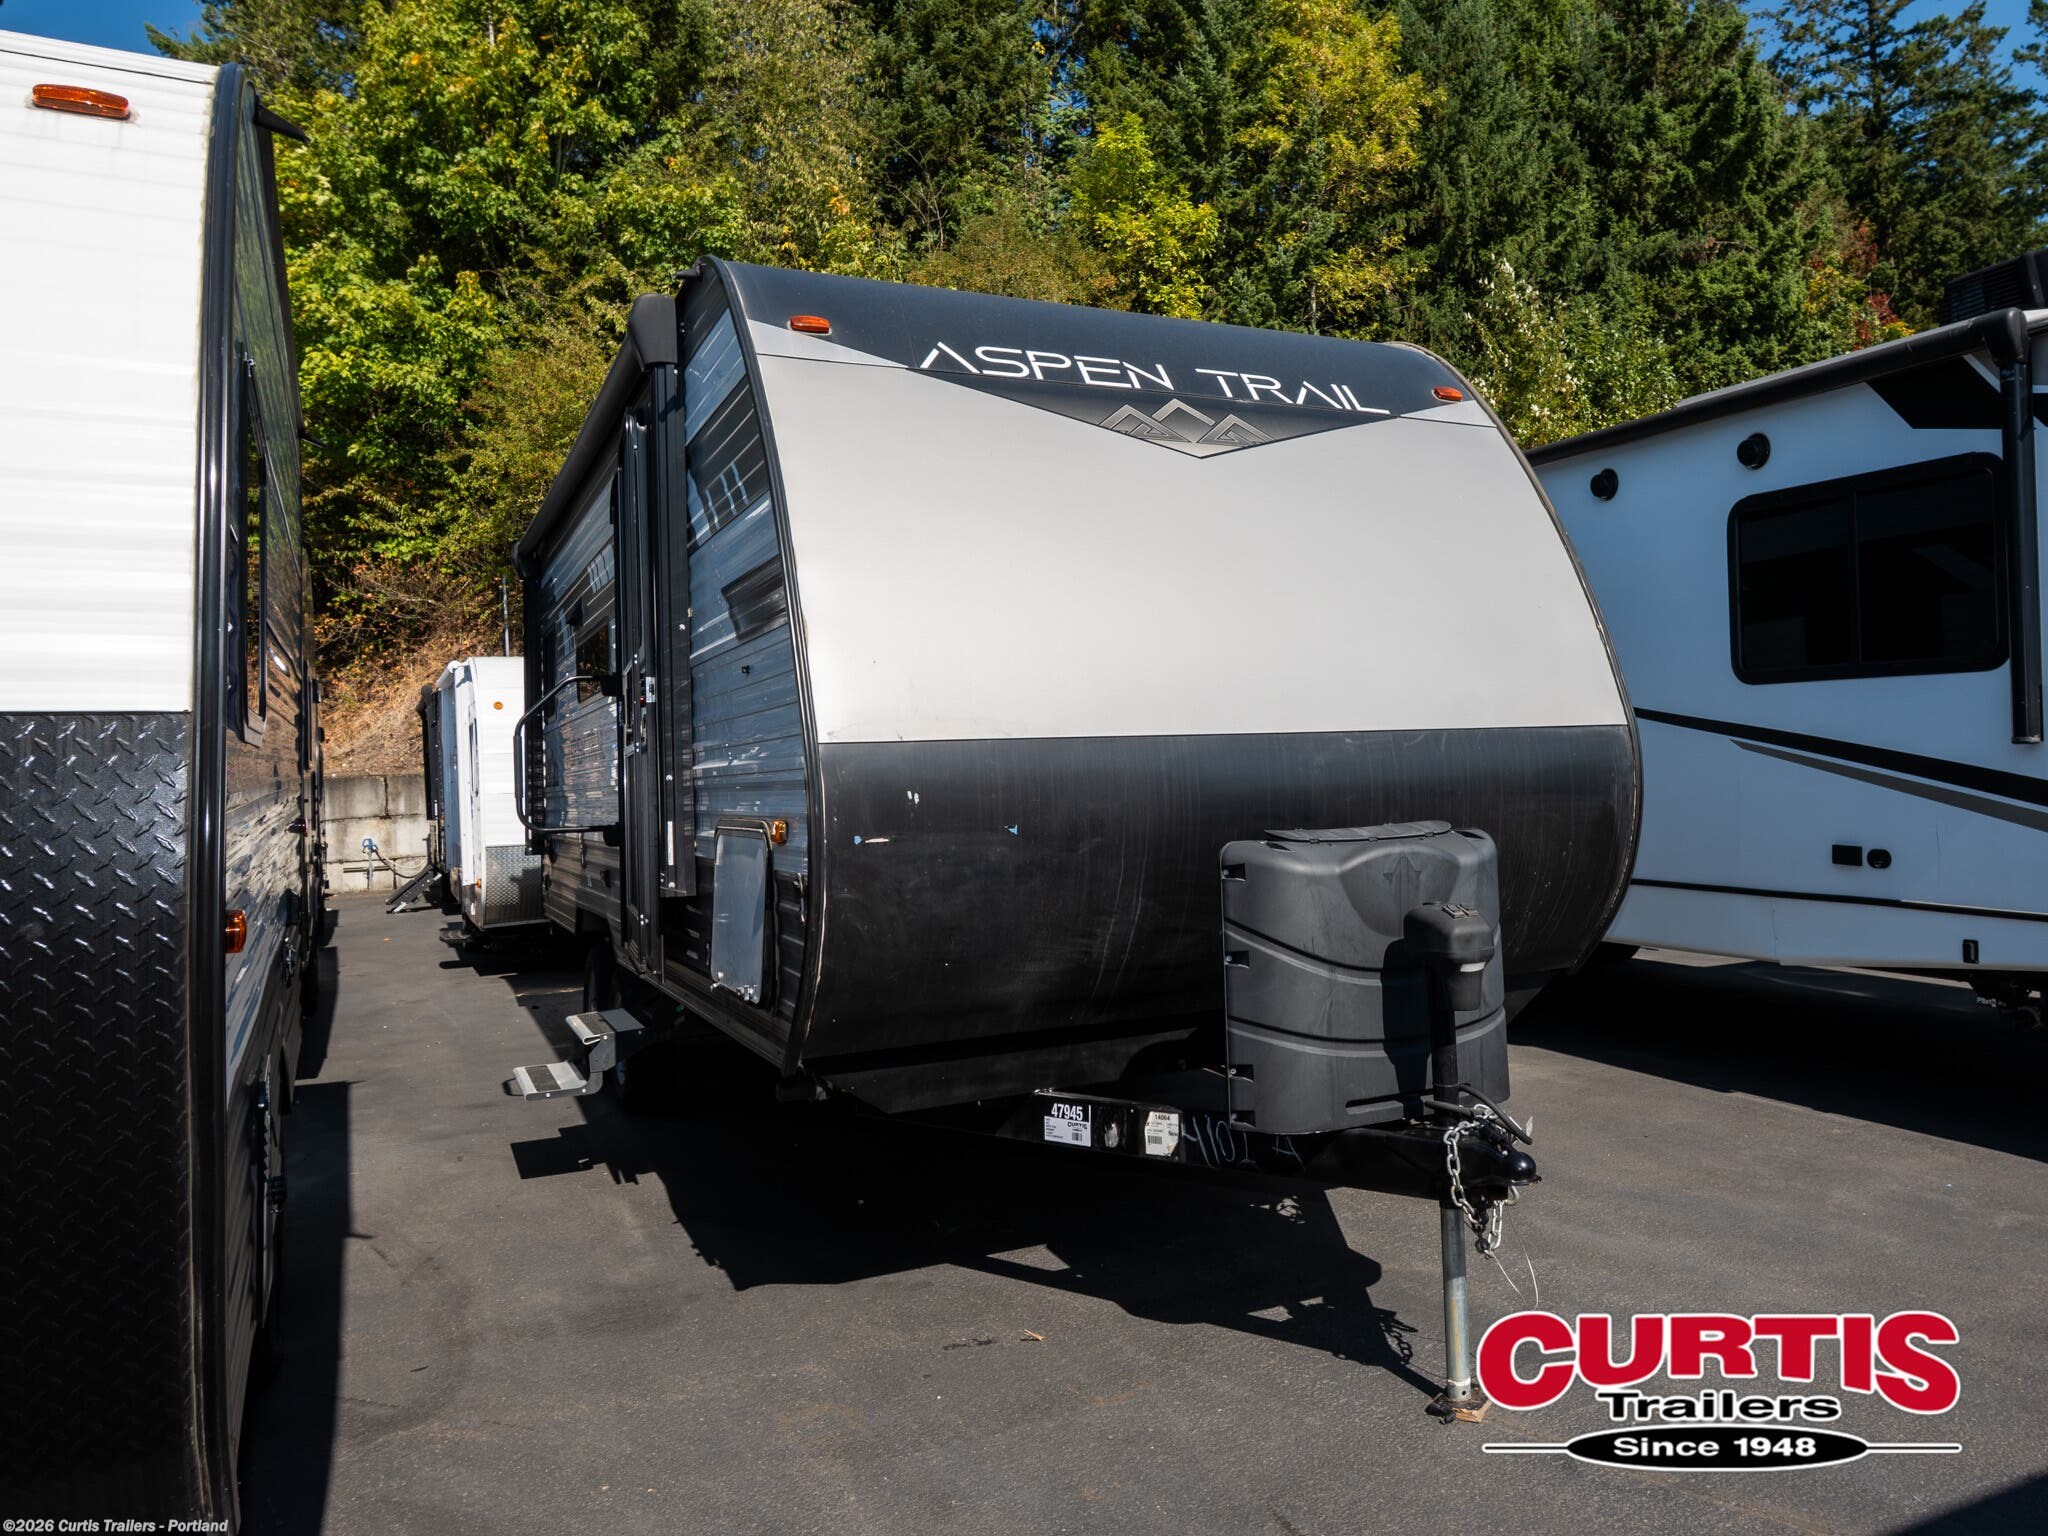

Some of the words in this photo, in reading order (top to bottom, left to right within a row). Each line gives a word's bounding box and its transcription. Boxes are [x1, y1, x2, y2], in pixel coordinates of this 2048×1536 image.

[919, 341, 1175, 391] ASPEN
[1195, 368, 1391, 415] TRAIL
[1051, 1103, 1083, 1121] 47945
